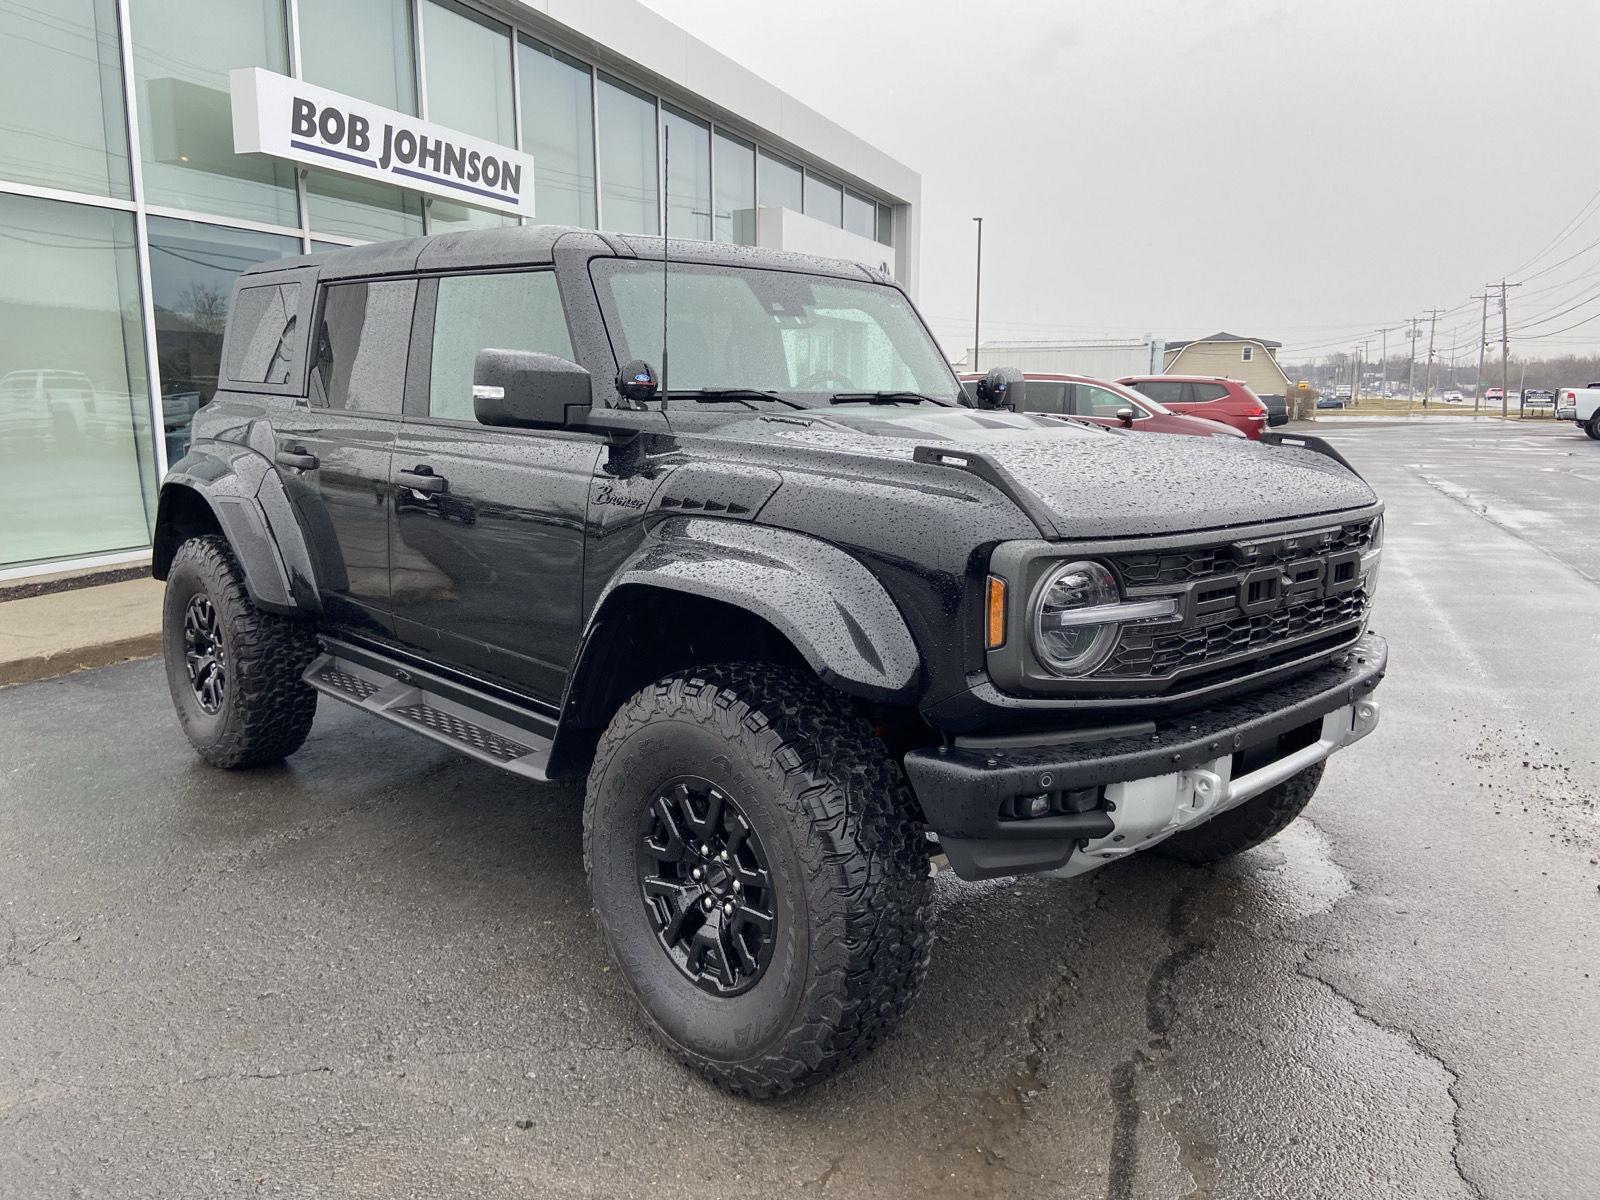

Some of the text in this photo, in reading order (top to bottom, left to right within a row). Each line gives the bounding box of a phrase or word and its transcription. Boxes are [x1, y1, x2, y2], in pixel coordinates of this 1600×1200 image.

[291, 97, 521, 194] BOB JOHNSON
[1187, 550, 1362, 627] FORD
